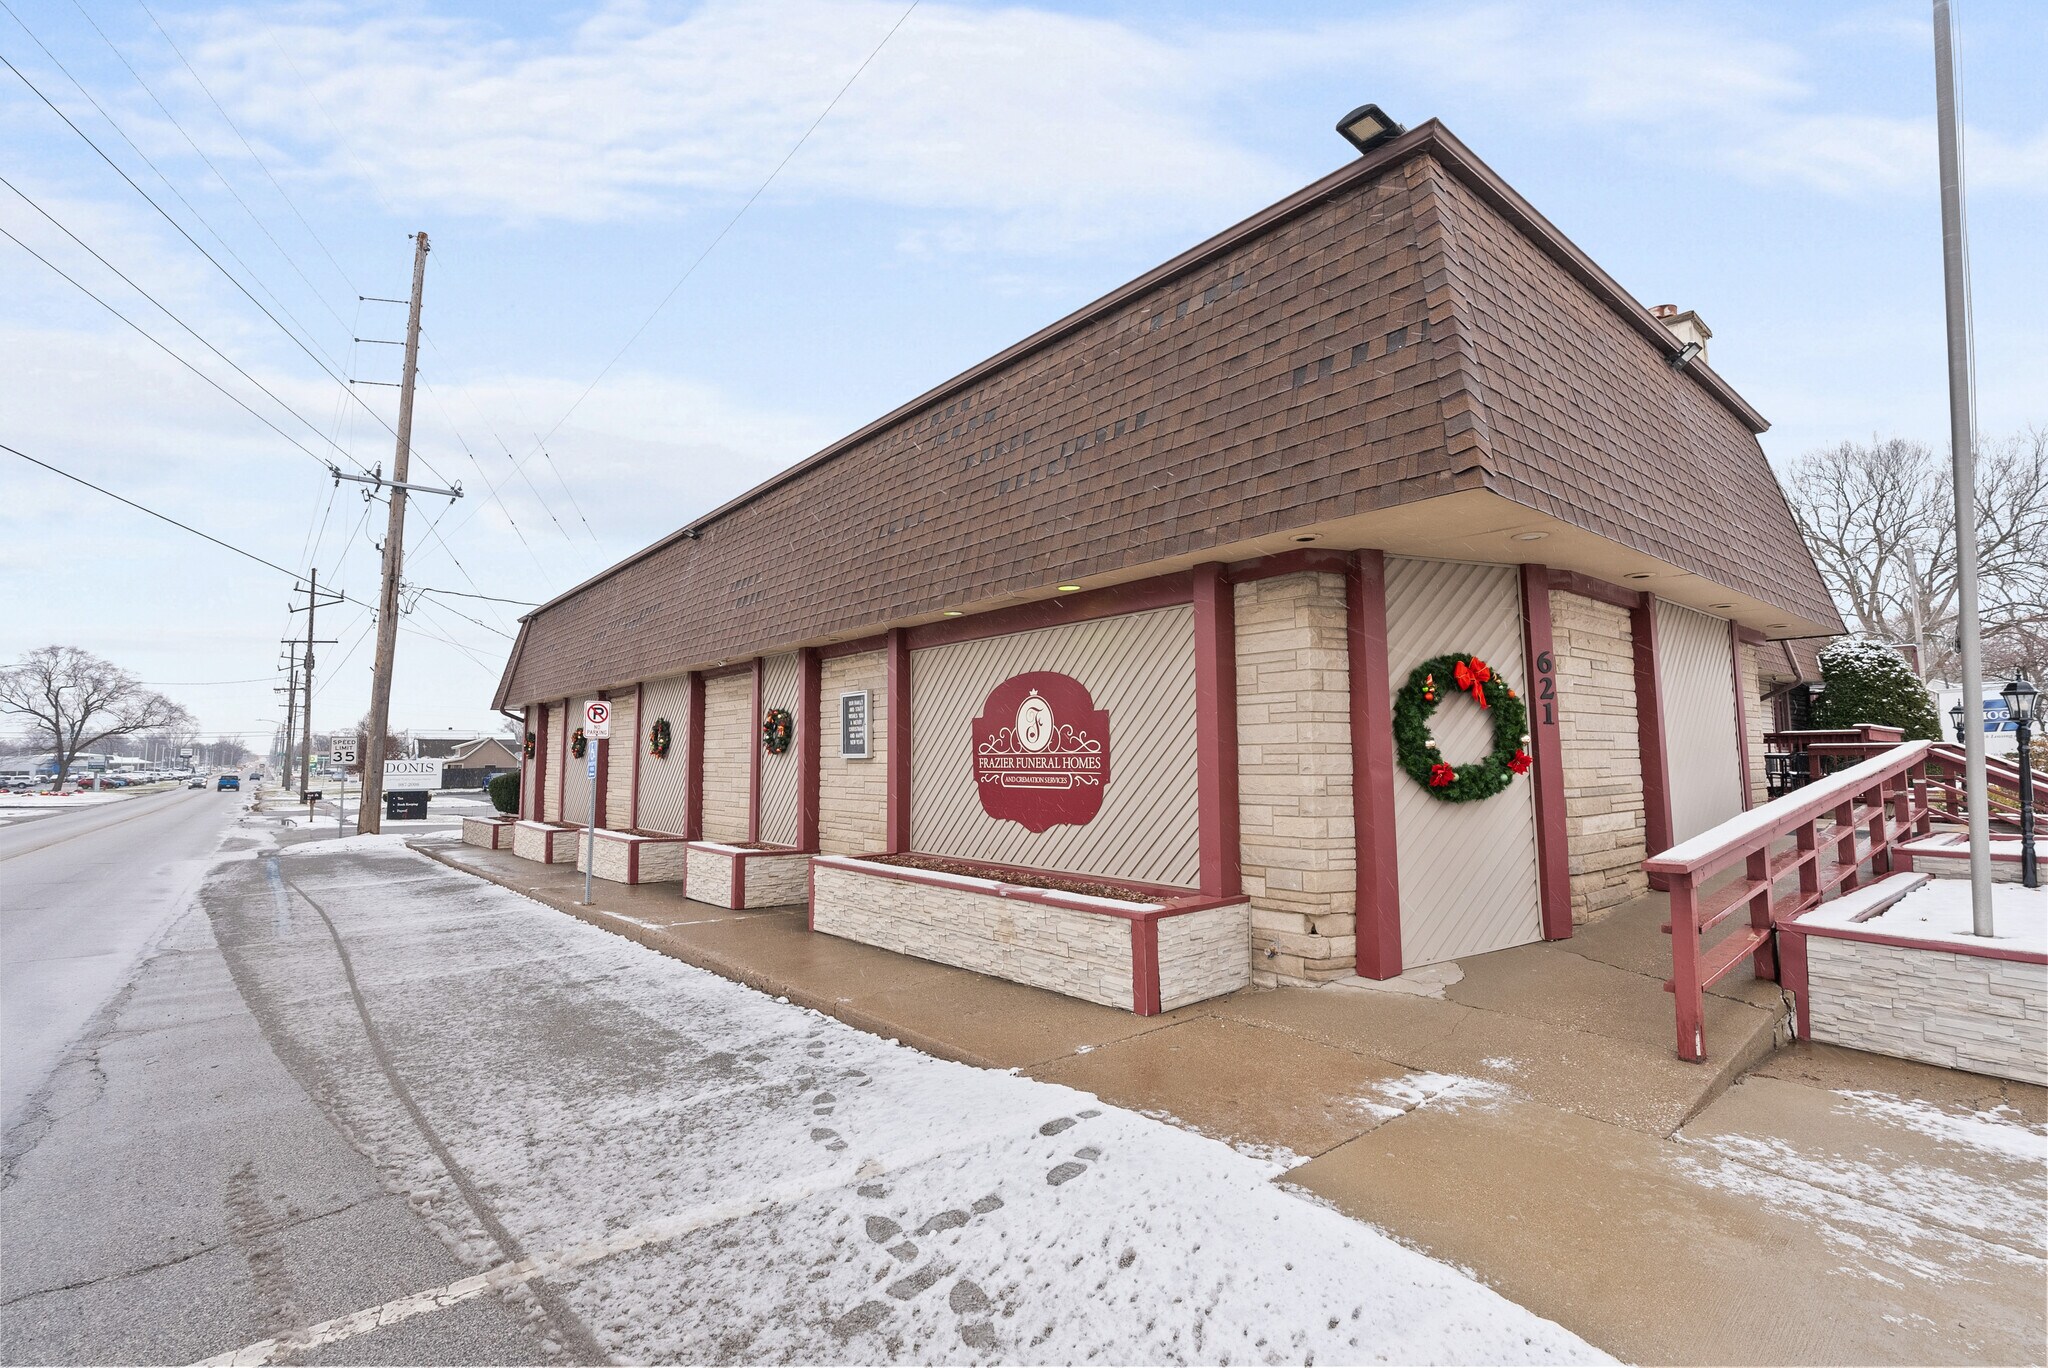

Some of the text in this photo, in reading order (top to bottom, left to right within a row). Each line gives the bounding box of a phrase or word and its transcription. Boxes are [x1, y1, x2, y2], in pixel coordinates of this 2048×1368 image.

[1536, 650, 1555, 725] 621
[333, 751, 355, 762] 35
[979, 756, 1101, 769] FRAZIER FUNERAL HOMES
[385, 762, 434, 773] DONIS
